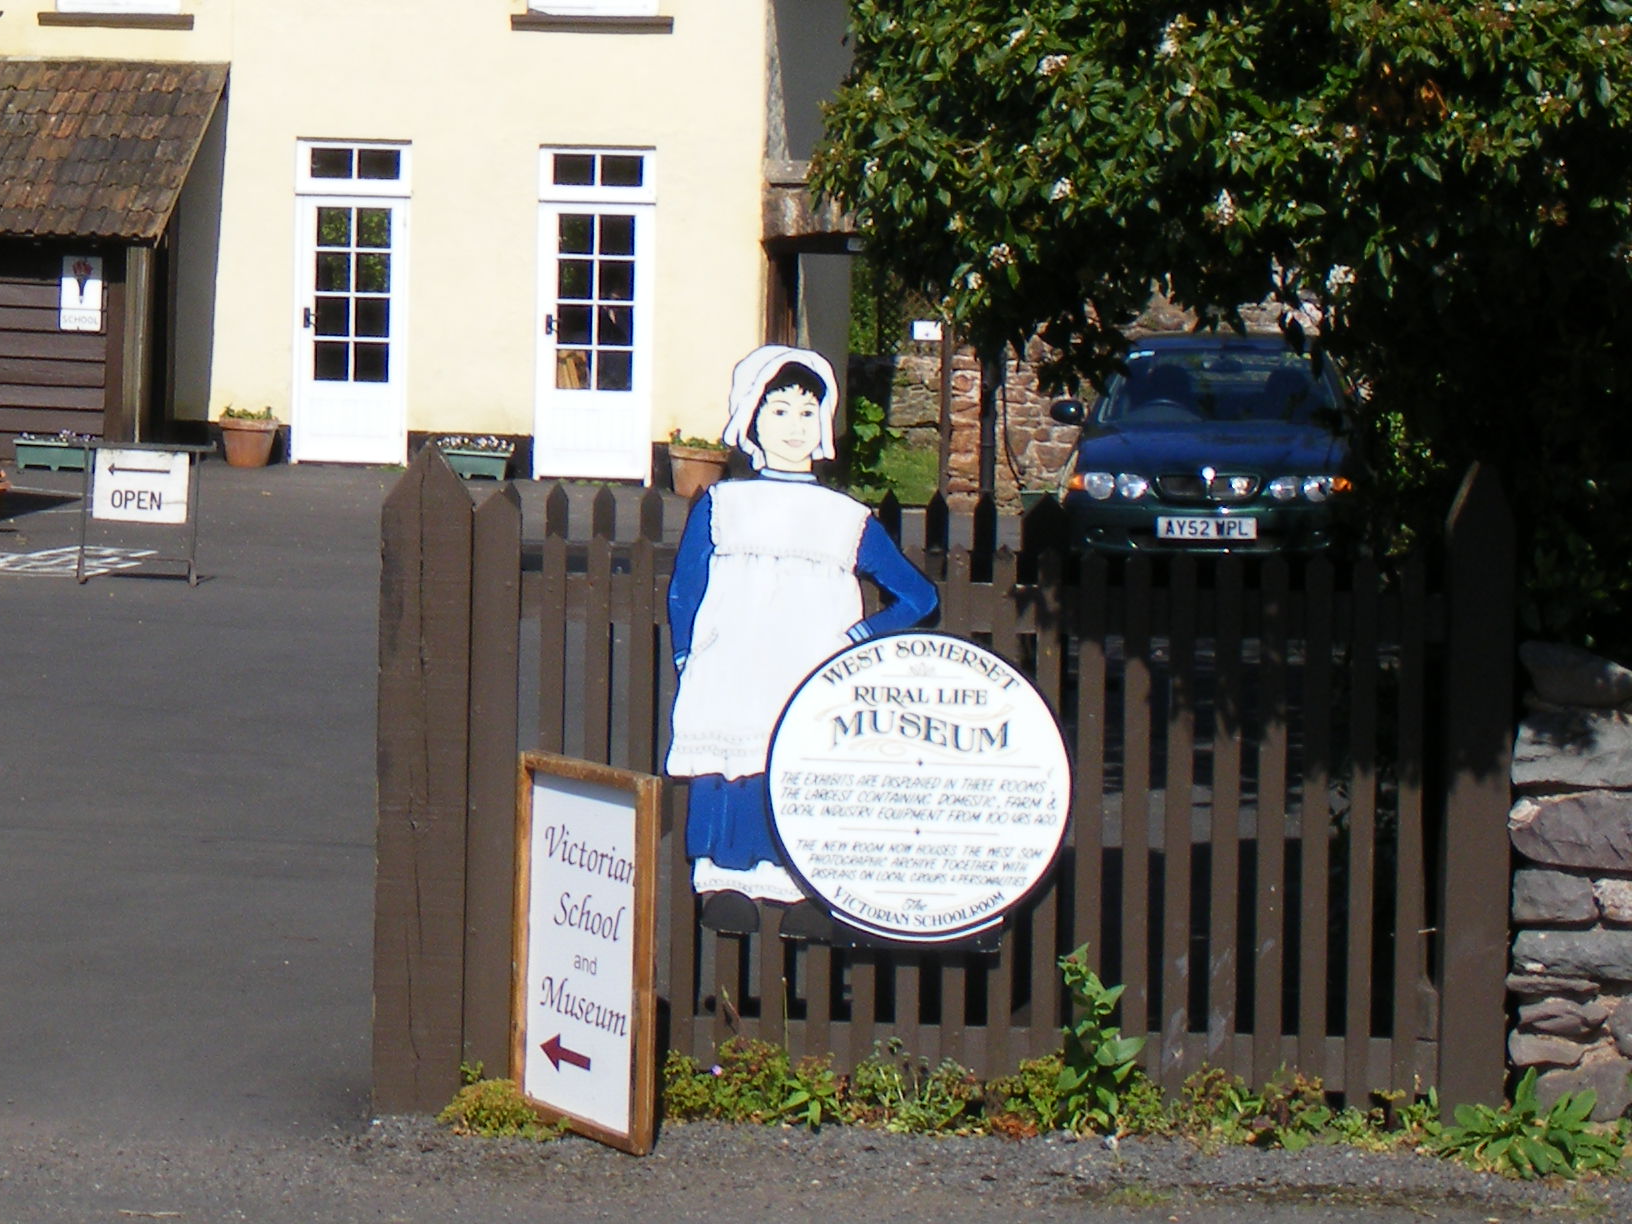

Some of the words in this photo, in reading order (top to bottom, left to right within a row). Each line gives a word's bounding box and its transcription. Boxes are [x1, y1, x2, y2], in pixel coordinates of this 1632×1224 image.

[62, 315, 99, 325] SCHOOL
[111, 489, 162, 511] OPEN
[1165, 520, 1210, 536] AY52
[821, 644, 884, 686] WEST
[896, 640, 1020, 691] SOMERSET
[853, 686, 929, 708] RURAL
[938, 688, 988, 705] LIFE
[832, 710, 1010, 753] MUSEUM
[780, 771, 803, 785] THE
[856, 774, 881, 788] ARE
[880, 774, 941, 790] DISPLAYED
[944, 777, 959, 790] IN
[961, 777, 996, 792] THREE
[780, 786, 803, 800] THE
[804, 788, 854, 802] LARGEST
[857, 789, 933, 805] CONTAINING
[1005, 795, 1043, 809] FARM
[1046, 797, 1056, 810] &
[780, 803, 815, 817] LOCAL
[820, 804, 875, 818] INDUSTRY
[877, 806, 945, 822] EQUIPMENT
[947, 809, 983, 823] FROM
[796, 839, 818, 851] THE
[822, 840, 848, 852] NEW
[852, 841, 886, 853] ROOM
[888, 843, 913, 854] NOW
[963, 845, 983, 857] THE
[987, 846, 1016, 858] WEST
[808, 853, 888, 867] PHOTOGRAPHIC
[891, 856, 937, 869] ARCHIVE
[942, 858, 999, 871] TOGETHER
[1002, 861, 1029, 873] WITH
[859, 870, 875, 881] ON
[876, 871, 905, 883] LOCAL
[833, 885, 909, 925] VICTORIAN
[913, 891, 1005, 927] SCHOOLROOM
[901, 898, 928, 912] The
[553, 891, 626, 942] School
[573, 954, 598, 976] and
[539, 976, 627, 1037] Museum
